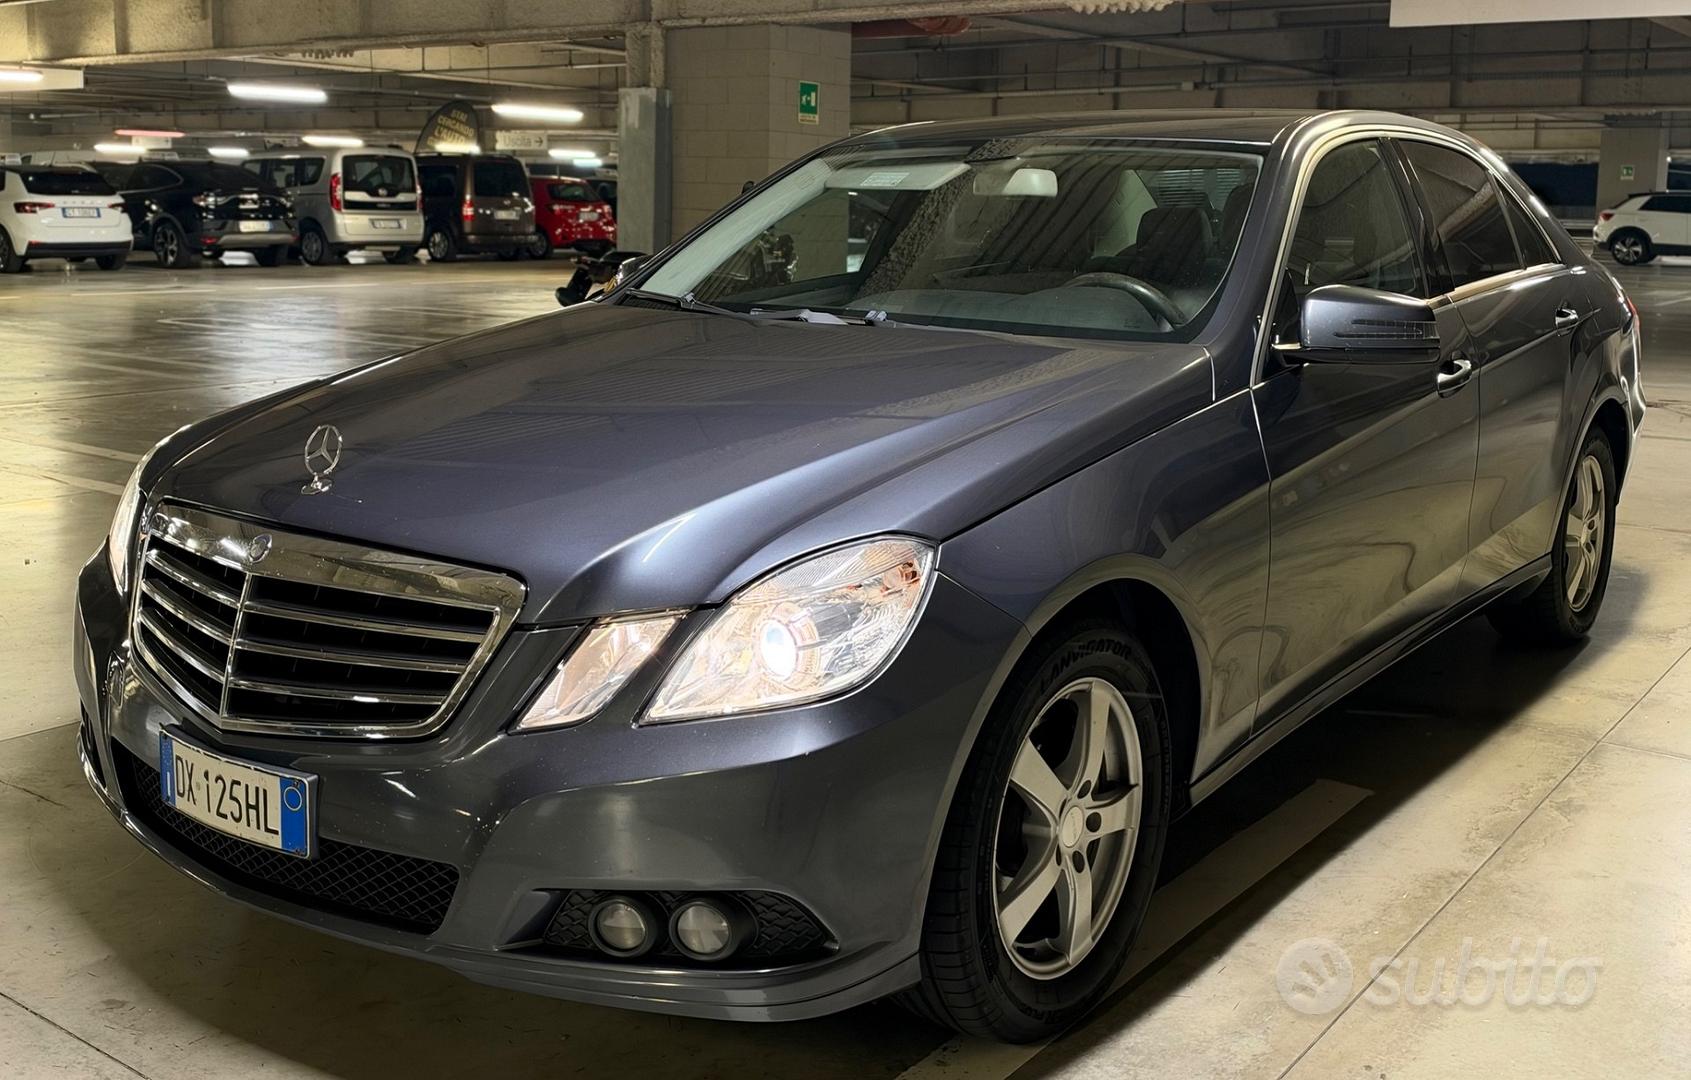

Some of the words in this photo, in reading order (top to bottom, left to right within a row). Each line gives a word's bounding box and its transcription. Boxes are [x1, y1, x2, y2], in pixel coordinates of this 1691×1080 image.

[503, 134, 532, 148] Uscita
[175, 754, 196, 806] DX
[204, 769, 279, 836] 125HL
